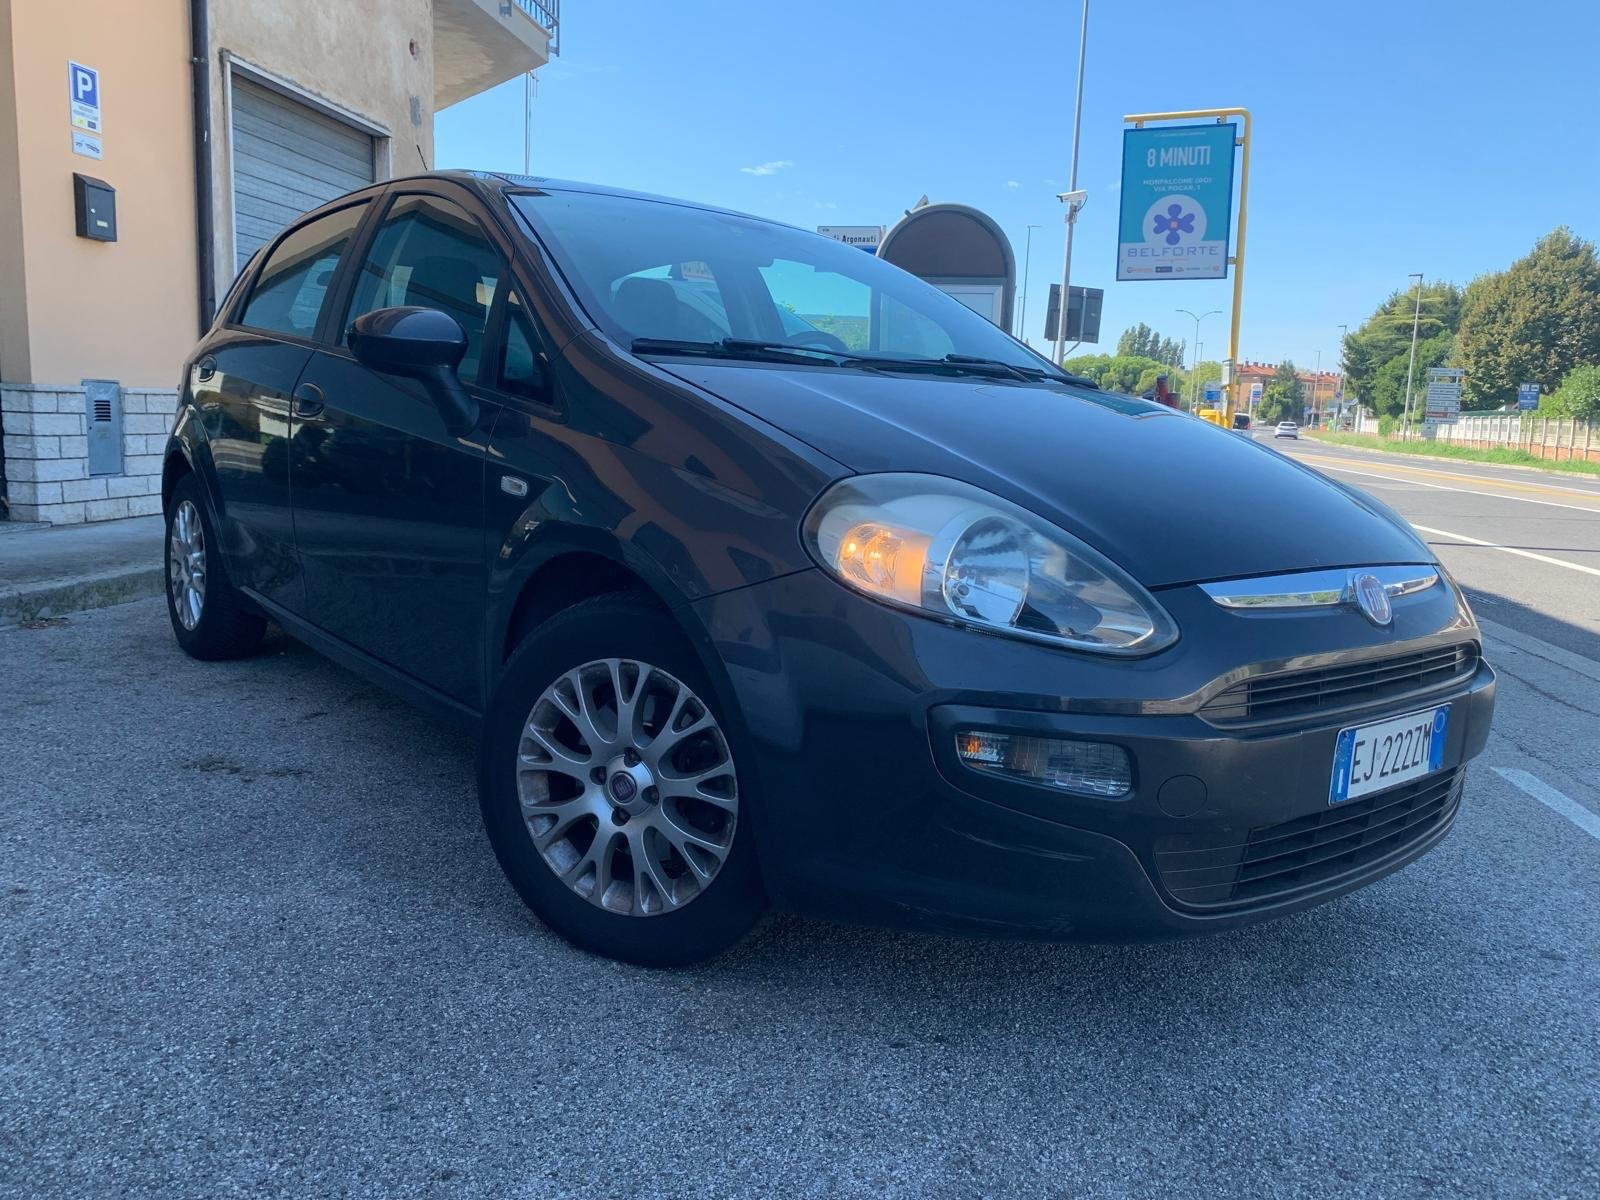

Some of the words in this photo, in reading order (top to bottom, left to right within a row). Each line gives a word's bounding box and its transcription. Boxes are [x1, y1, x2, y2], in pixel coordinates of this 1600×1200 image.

[77, 70, 92, 99] P
[1147, 148, 1157, 168] 8
[1160, 145, 1211, 168] MINUTI
[841, 234, 877, 244] Argonauti
[1127, 246, 1219, 258] BELFORTE
